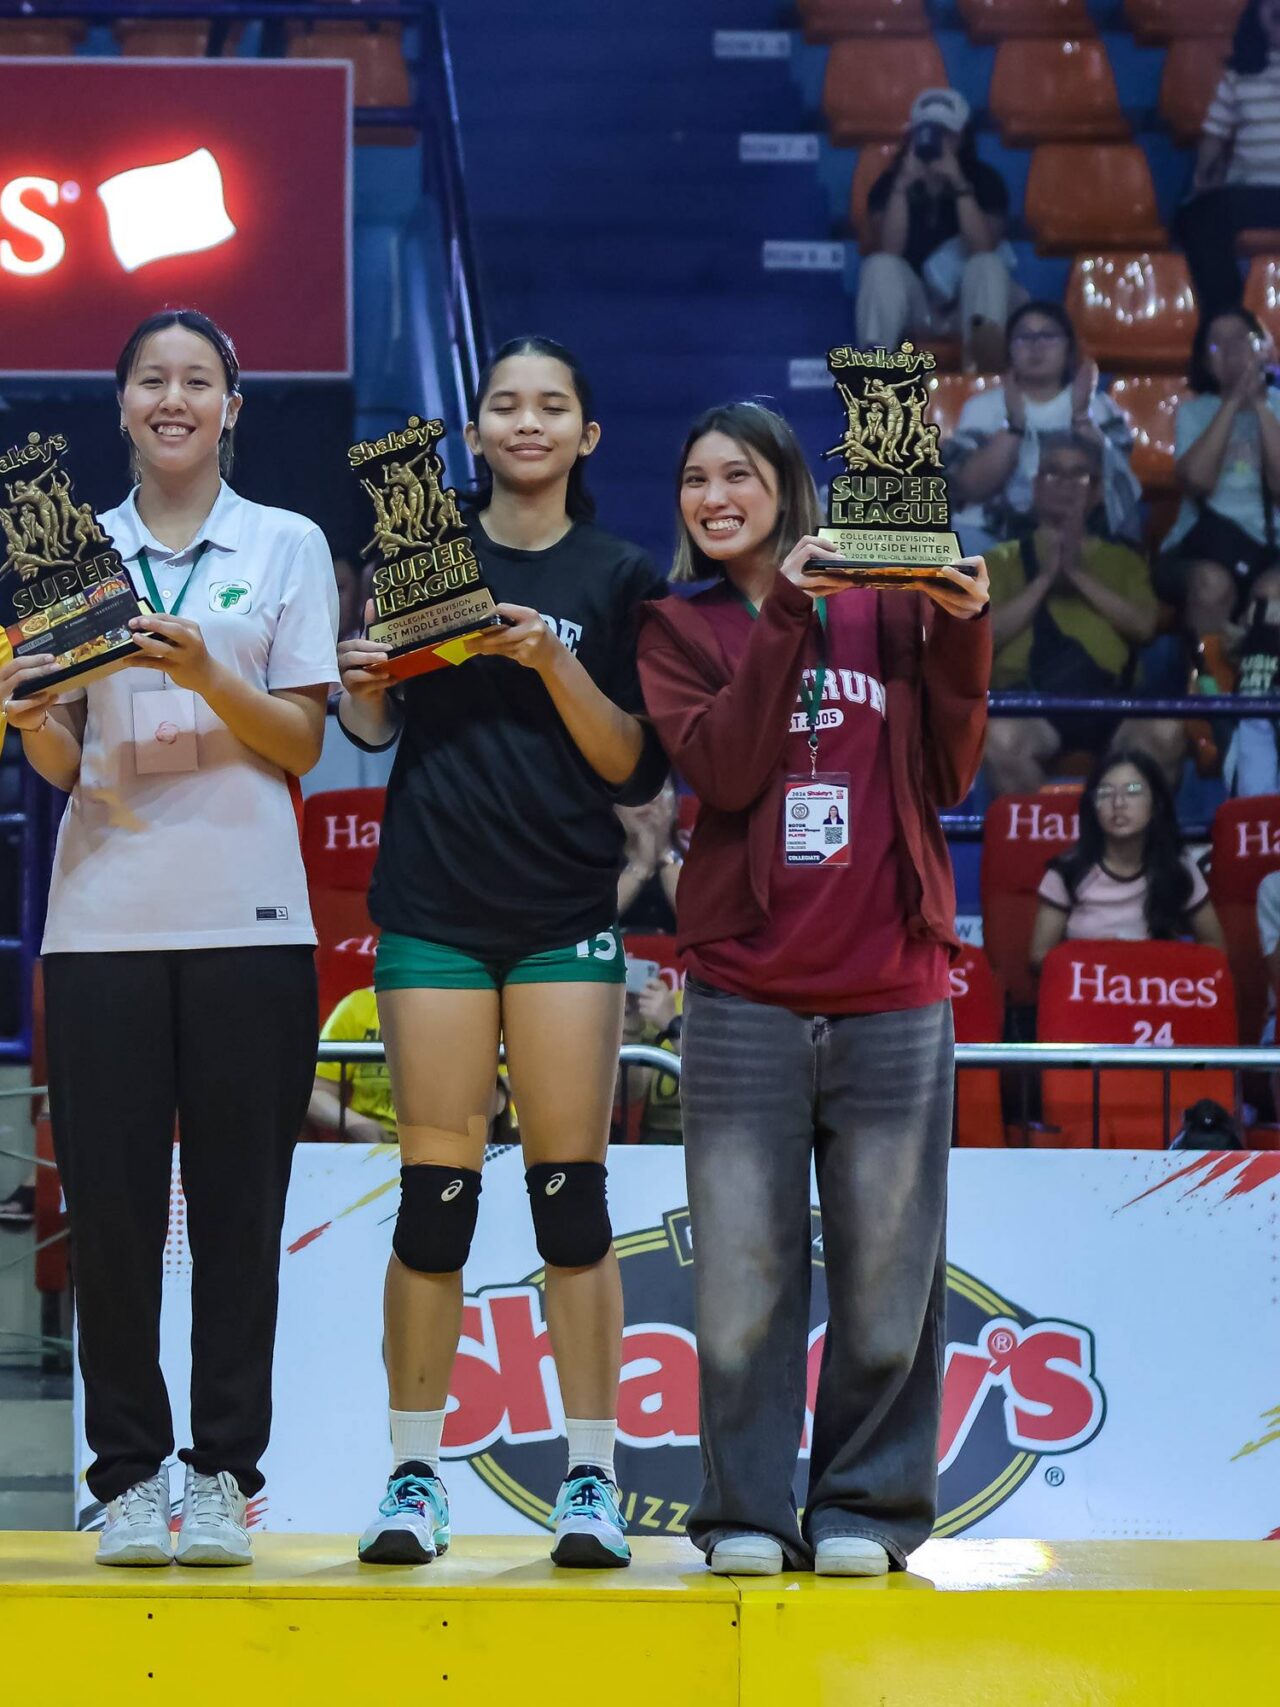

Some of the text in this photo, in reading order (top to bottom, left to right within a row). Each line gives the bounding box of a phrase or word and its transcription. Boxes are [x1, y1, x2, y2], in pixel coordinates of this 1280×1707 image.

[830, 347, 936, 372] Shakey's
[348, 419, 444, 467] Shakey's
[832, 475, 947, 501] SUPER
[831, 502, 948, 525] LEAGUE
[840, 533, 935, 543] COLLEGIATE DIVISION
[856, 542, 907, 552] OUTSIDE
[910, 544, 950, 554] HITTER
[373, 537, 475, 595] SUPER
[13, 551, 124, 619] SUPER
[376, 561, 480, 618] LEAGUE
[387, 611, 433, 631] COLLEGIATE
[436, 598, 471, 615] DIVISION
[401, 618, 439, 637] MIDDLE
[442, 602, 488, 623] BLOCKER
[1070, 961, 1218, 1008] Hanes
[1132, 1020, 1175, 1047] 24
